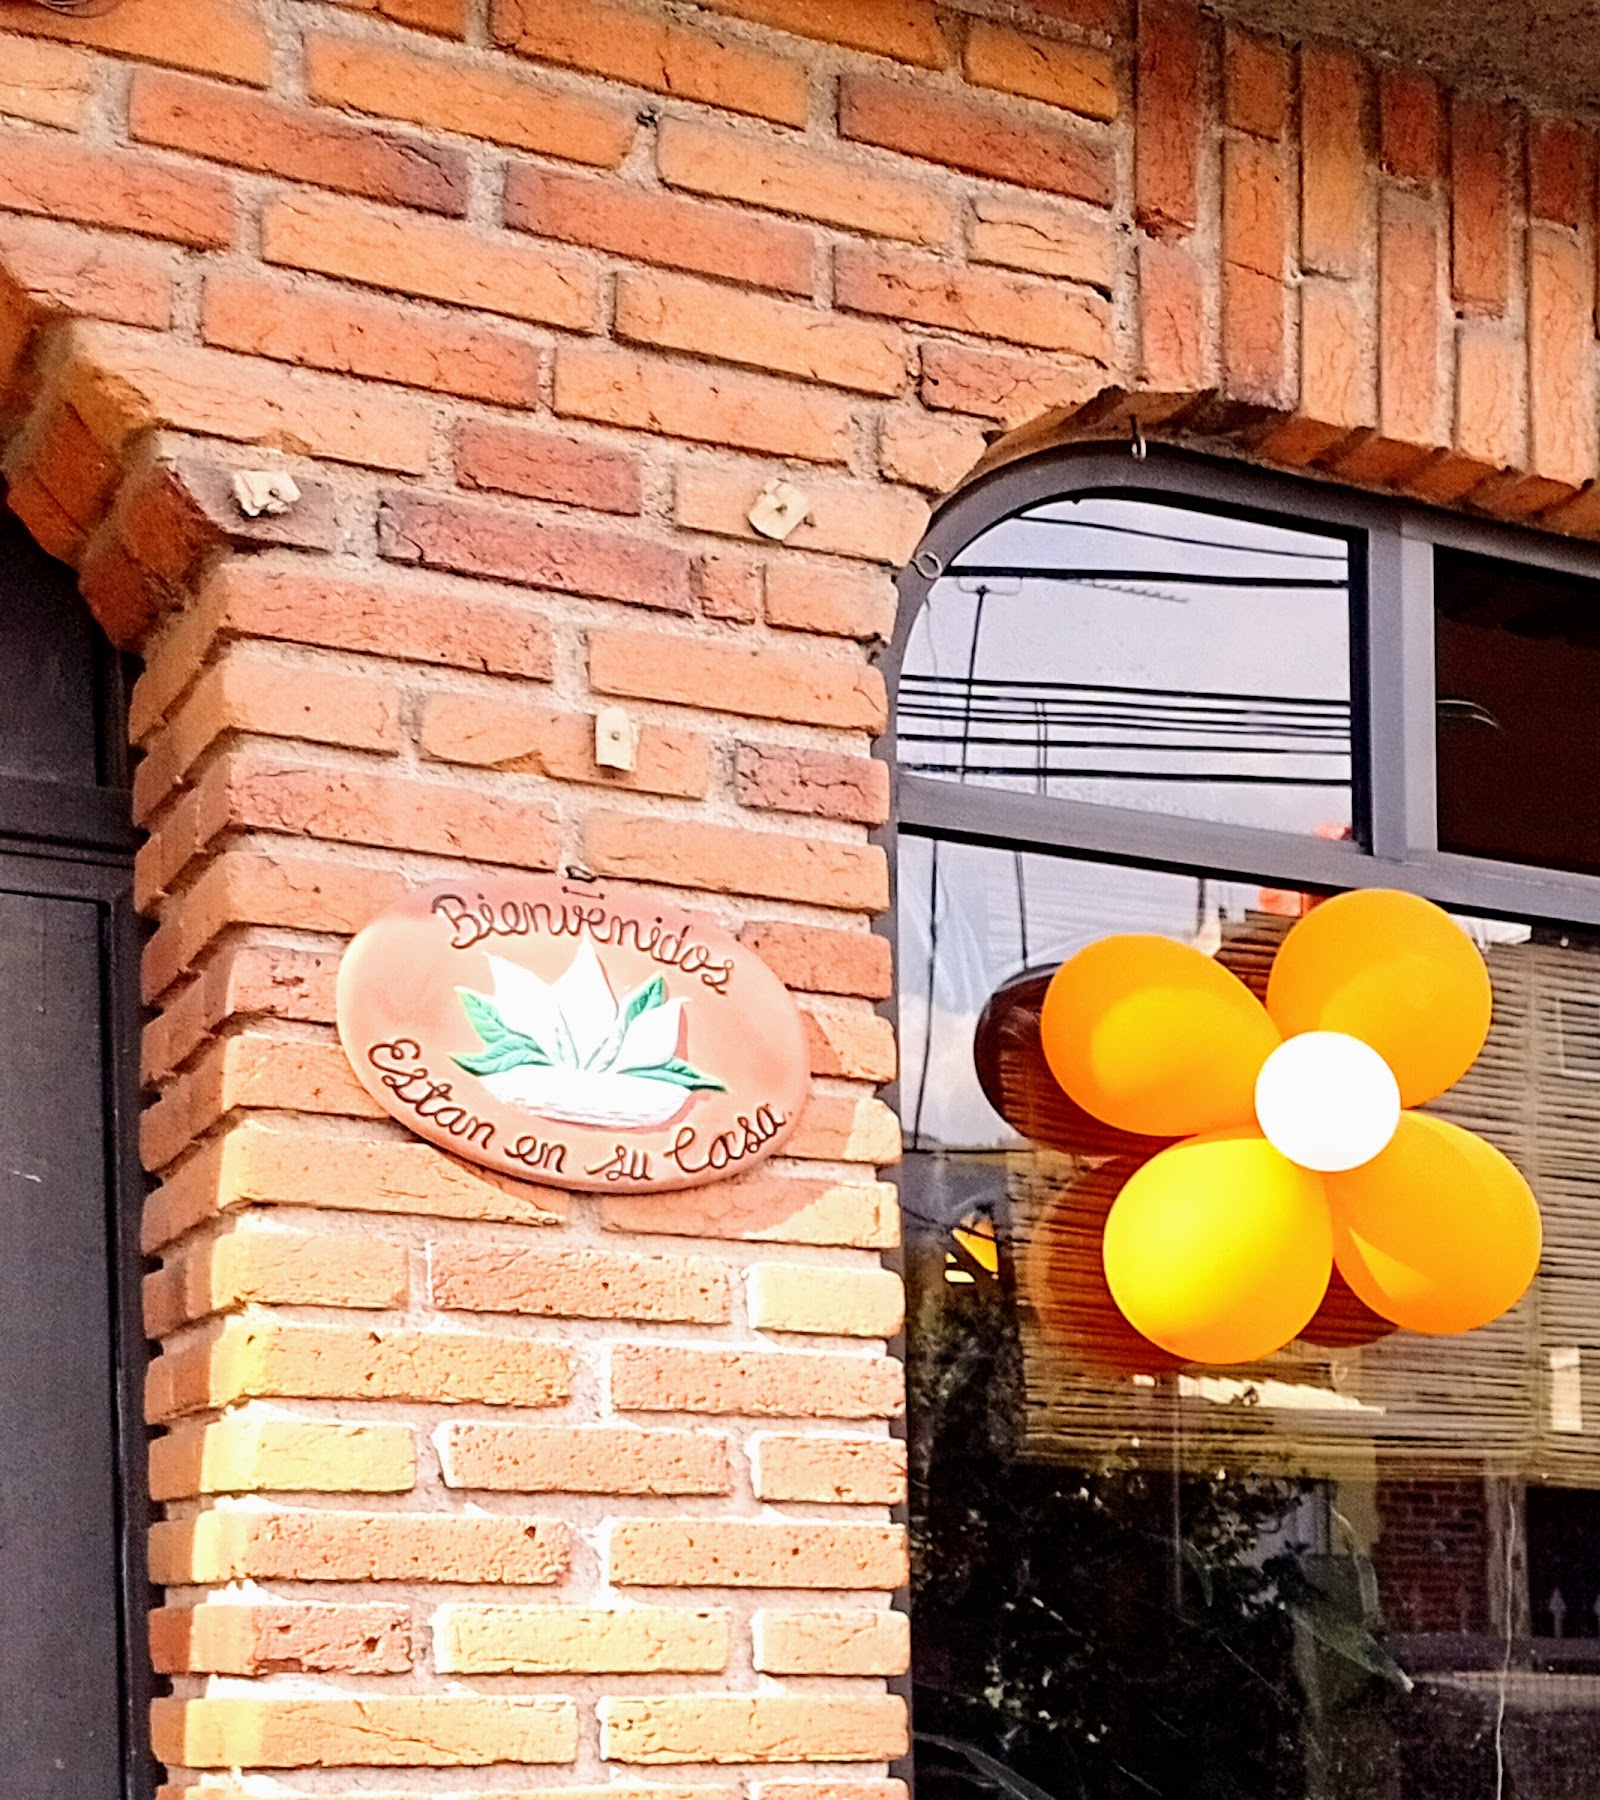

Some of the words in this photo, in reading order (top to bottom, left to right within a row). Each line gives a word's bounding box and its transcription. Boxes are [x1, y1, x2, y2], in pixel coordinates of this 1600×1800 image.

[432, 893, 735, 995] Bienvenidos
[368, 1037, 495, 1150] Estan
[505, 1135, 568, 1174] en
[584, 1143, 655, 1181] su
